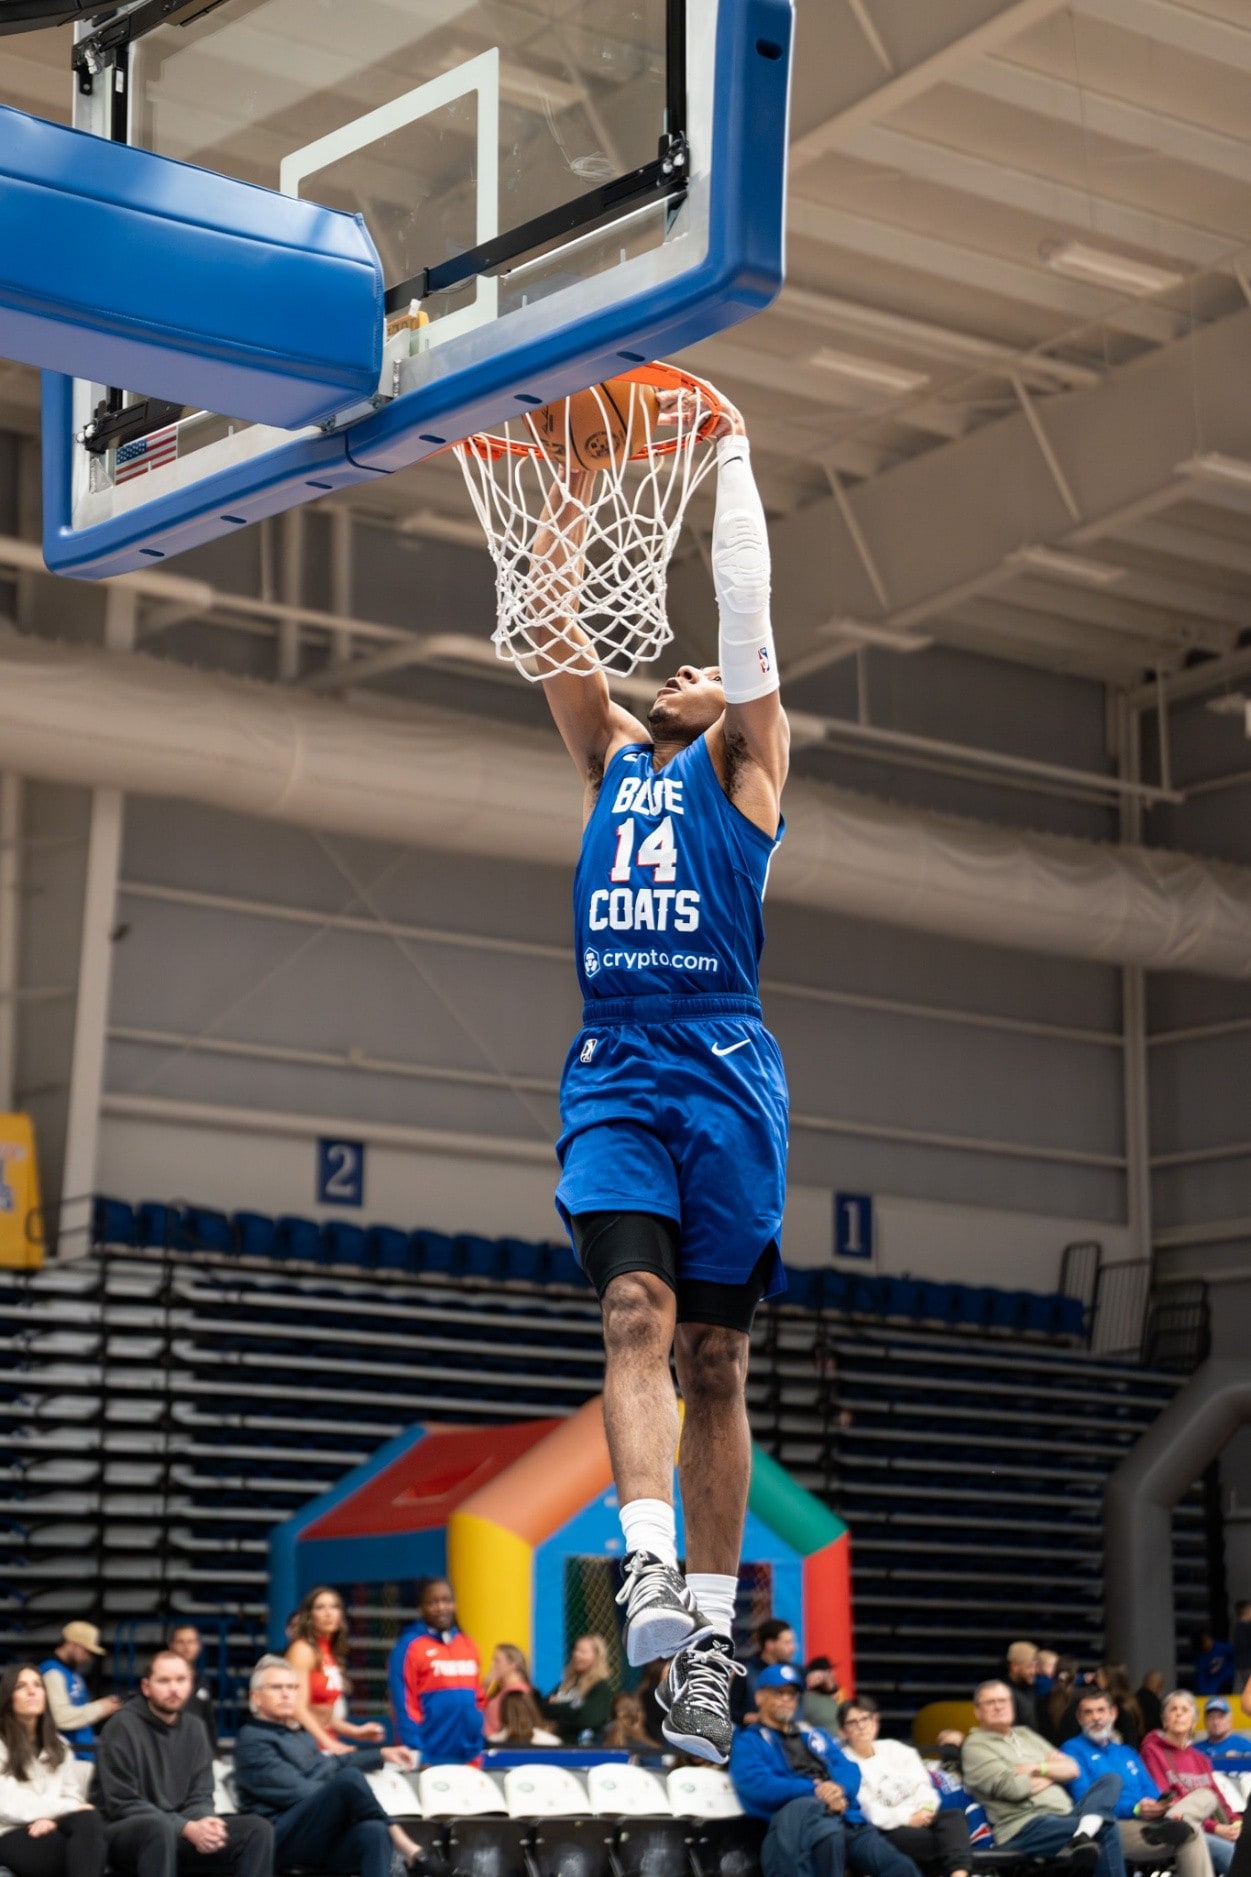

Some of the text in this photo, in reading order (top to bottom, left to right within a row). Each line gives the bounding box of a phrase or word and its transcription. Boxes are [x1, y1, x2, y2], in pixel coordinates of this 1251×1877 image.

[612, 776, 684, 816] BLUE
[609, 816, 678, 883] 14
[588, 888, 700, 932] COATS
[602, 949, 718, 972] crypto.com
[326, 1146, 356, 1197] 2
[843, 1201, 863, 1253] 1
